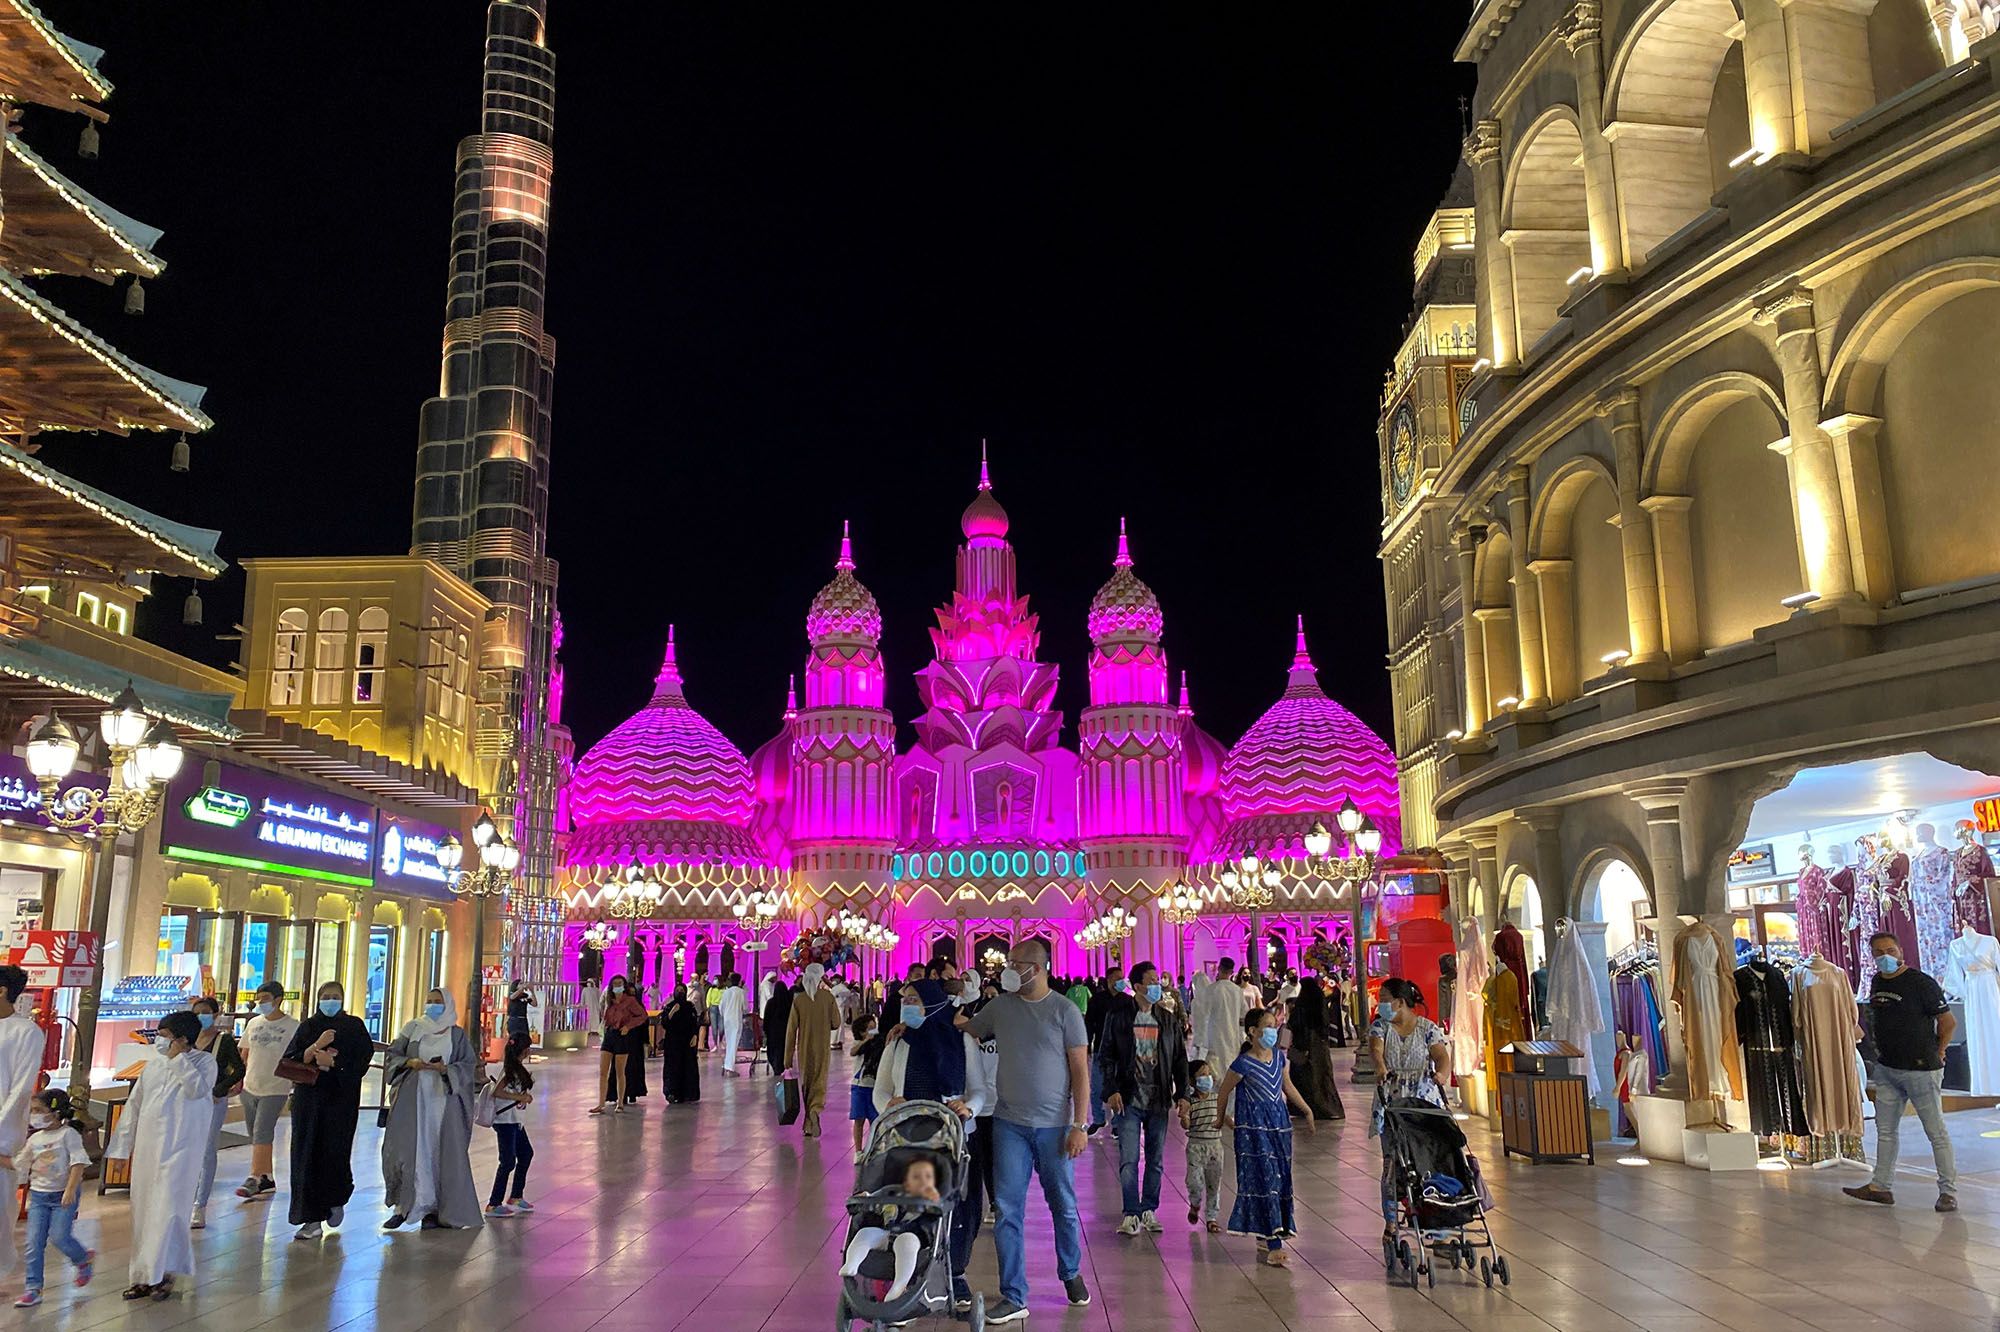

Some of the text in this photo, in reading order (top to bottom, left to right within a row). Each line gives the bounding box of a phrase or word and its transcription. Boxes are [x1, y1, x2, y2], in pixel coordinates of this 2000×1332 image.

[1974, 798, 2000, 833] SA
[259, 820, 368, 862] AL GHURAIR EXCHANGE
